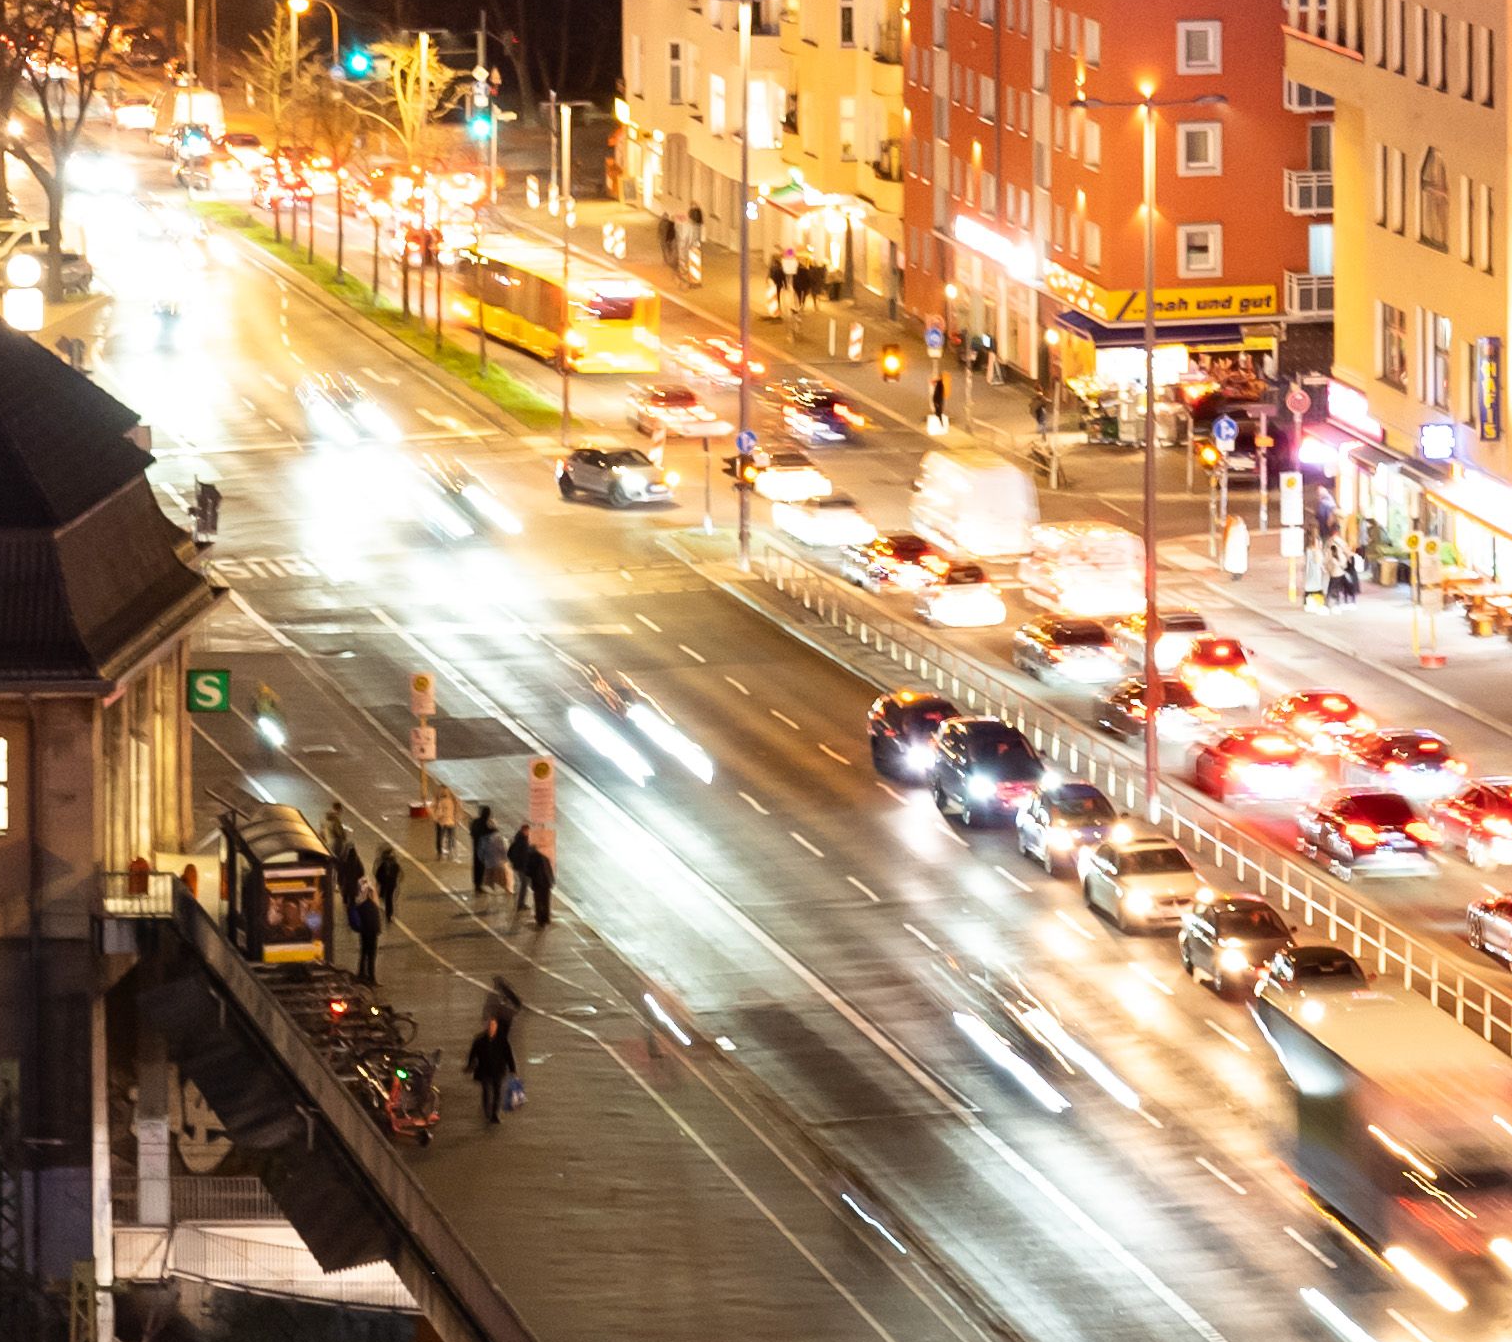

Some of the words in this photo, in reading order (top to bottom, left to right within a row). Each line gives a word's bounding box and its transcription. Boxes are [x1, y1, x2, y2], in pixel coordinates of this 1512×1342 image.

[1196, 295, 1233, 310] und
[1239, 295, 1272, 312] gut
[194, 674, 223, 708] S
